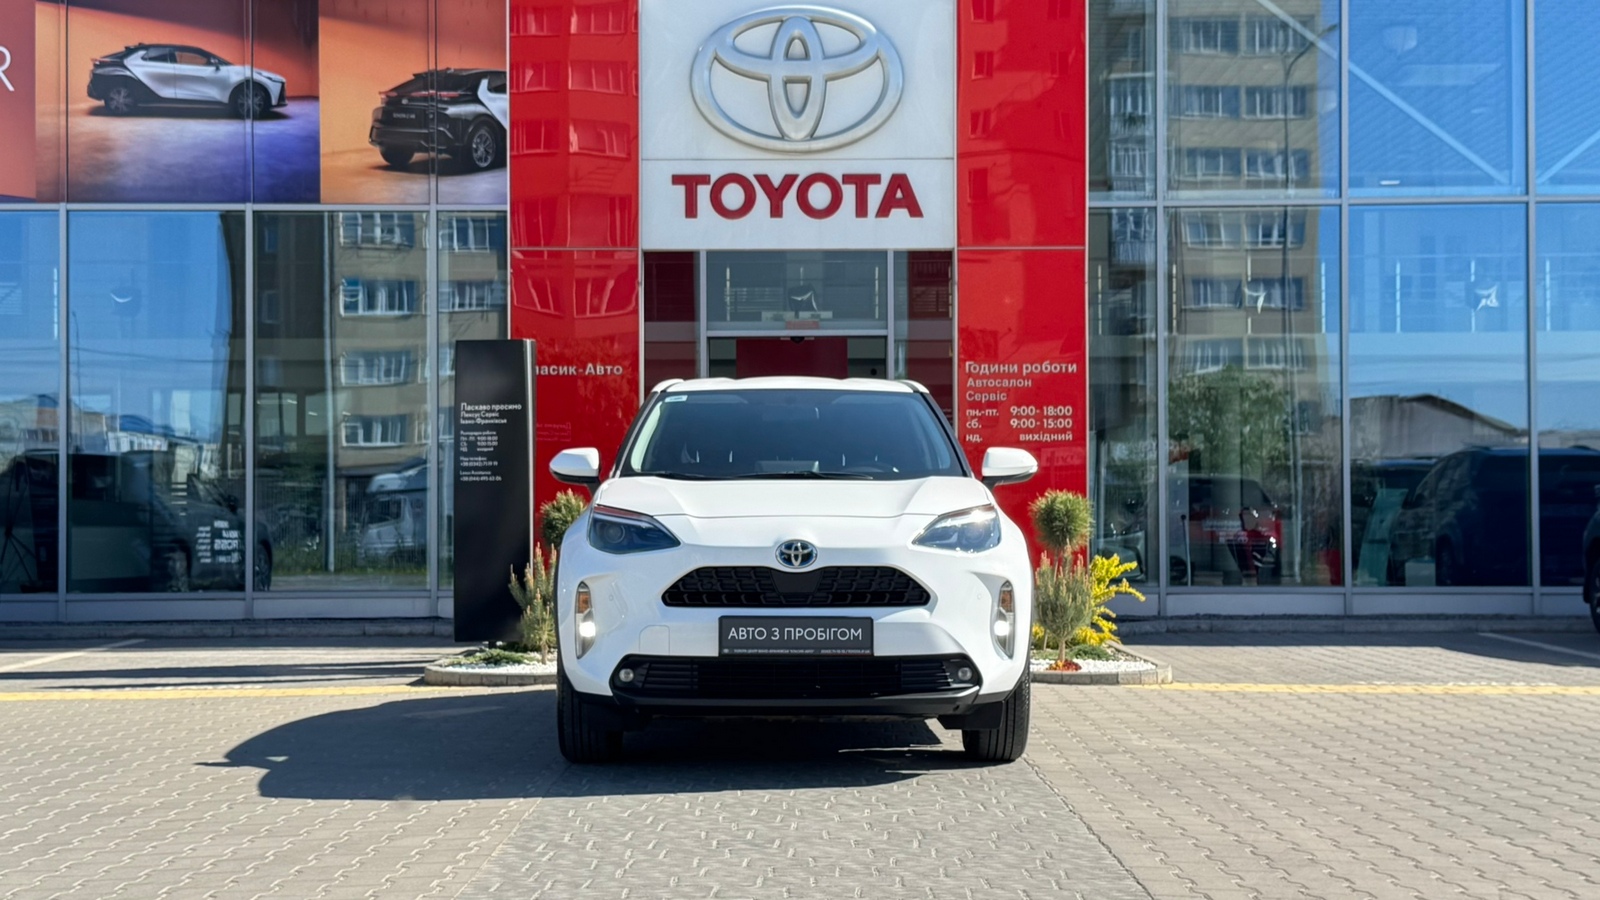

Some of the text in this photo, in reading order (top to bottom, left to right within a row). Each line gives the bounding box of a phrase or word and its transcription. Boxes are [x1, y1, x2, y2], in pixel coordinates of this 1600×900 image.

[671, 173, 924, 219] TOYOTA
[965, 360, 1077, 376] Години роботи
[966, 377, 1032, 388] Автосалон
[965, 391, 1008, 403] Сервіс
[491, 403, 522, 413] просимо
[966, 418, 982, 429] сб.
[965, 431, 1073, 443] нд. вихідний
[727, 627, 863, 641] АВТО З ПРОБІГОМ
